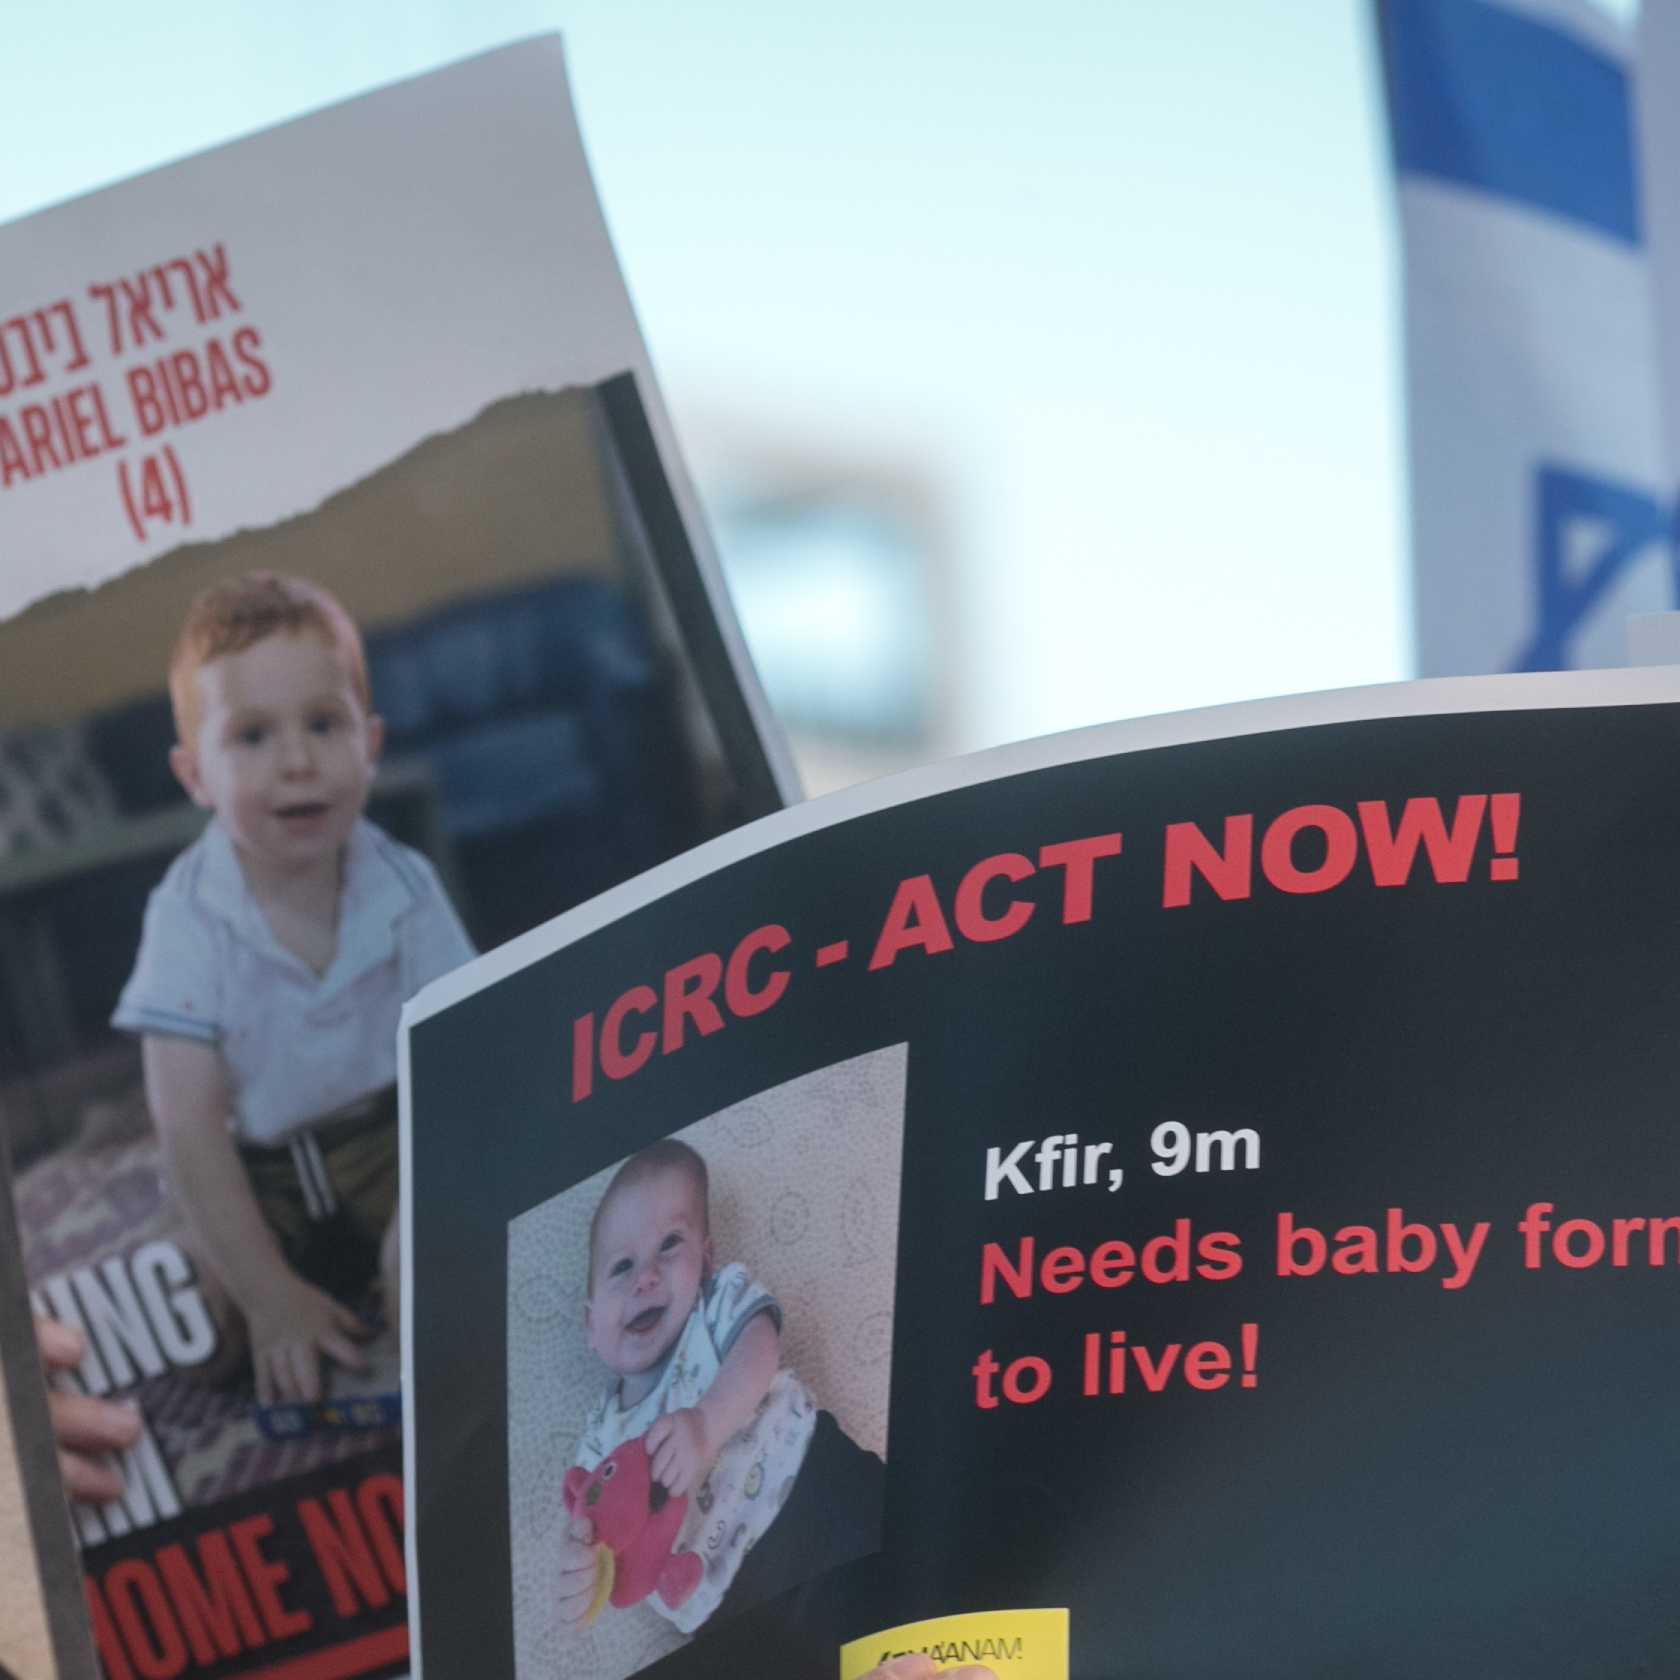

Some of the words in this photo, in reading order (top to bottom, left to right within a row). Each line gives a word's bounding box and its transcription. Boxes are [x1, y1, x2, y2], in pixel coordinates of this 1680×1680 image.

[87, 242, 243, 357] אריאל
[125, 323, 273, 440] BIBAS
[117, 442, 193, 543] (4)
[570, 922, 793, 1103] ICRC
[866, 831, 1124, 972] ACT
[1161, 791, 1521, 910] NOW!
[983, 1130, 1125, 1201] Kfir,
[1148, 1119, 1262, 1179] 9m
[979, 1217, 1244, 1305] Needs
[1274, 1207, 1492, 1290] baby
[971, 1347, 1052, 1410] to
[1081, 1322, 1261, 1398] live!
